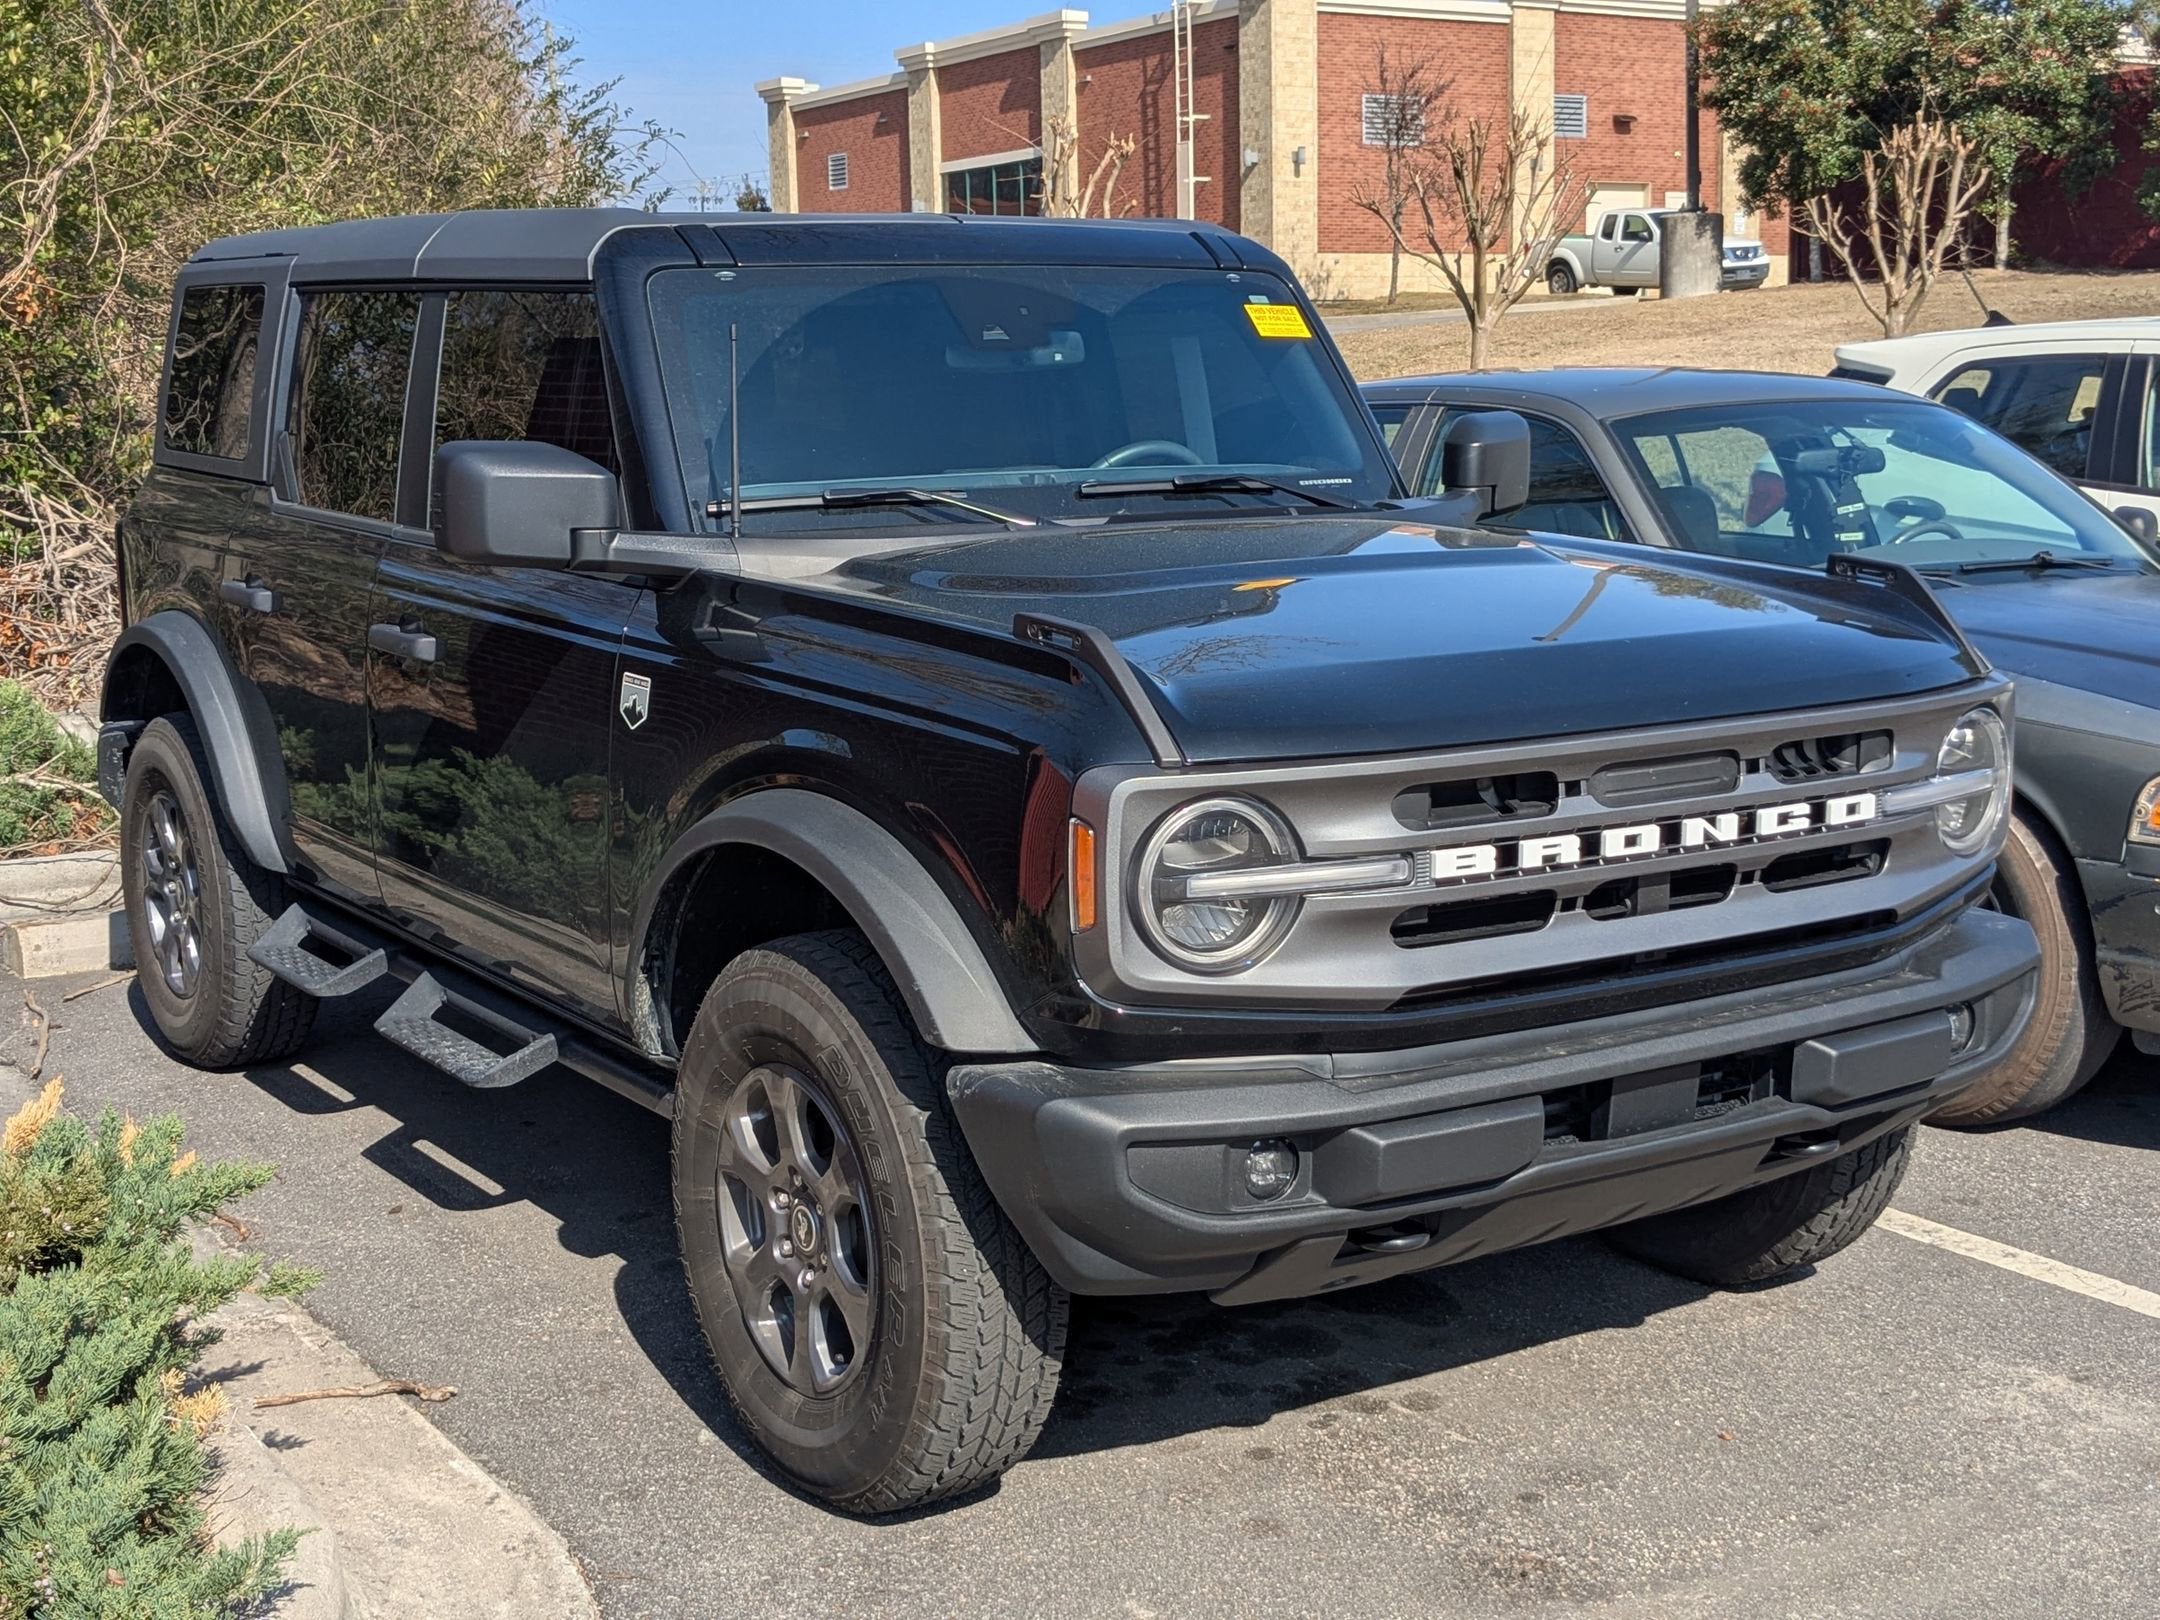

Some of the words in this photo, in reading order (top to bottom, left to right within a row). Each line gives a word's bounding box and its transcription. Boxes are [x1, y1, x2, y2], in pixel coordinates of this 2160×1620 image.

[1249, 307, 1265, 315] THIS
[1266, 307, 1296, 315] VEHICLE
[1430, 792, 1876, 880] BRONCO
[816, 1044, 908, 1348] DUELER
